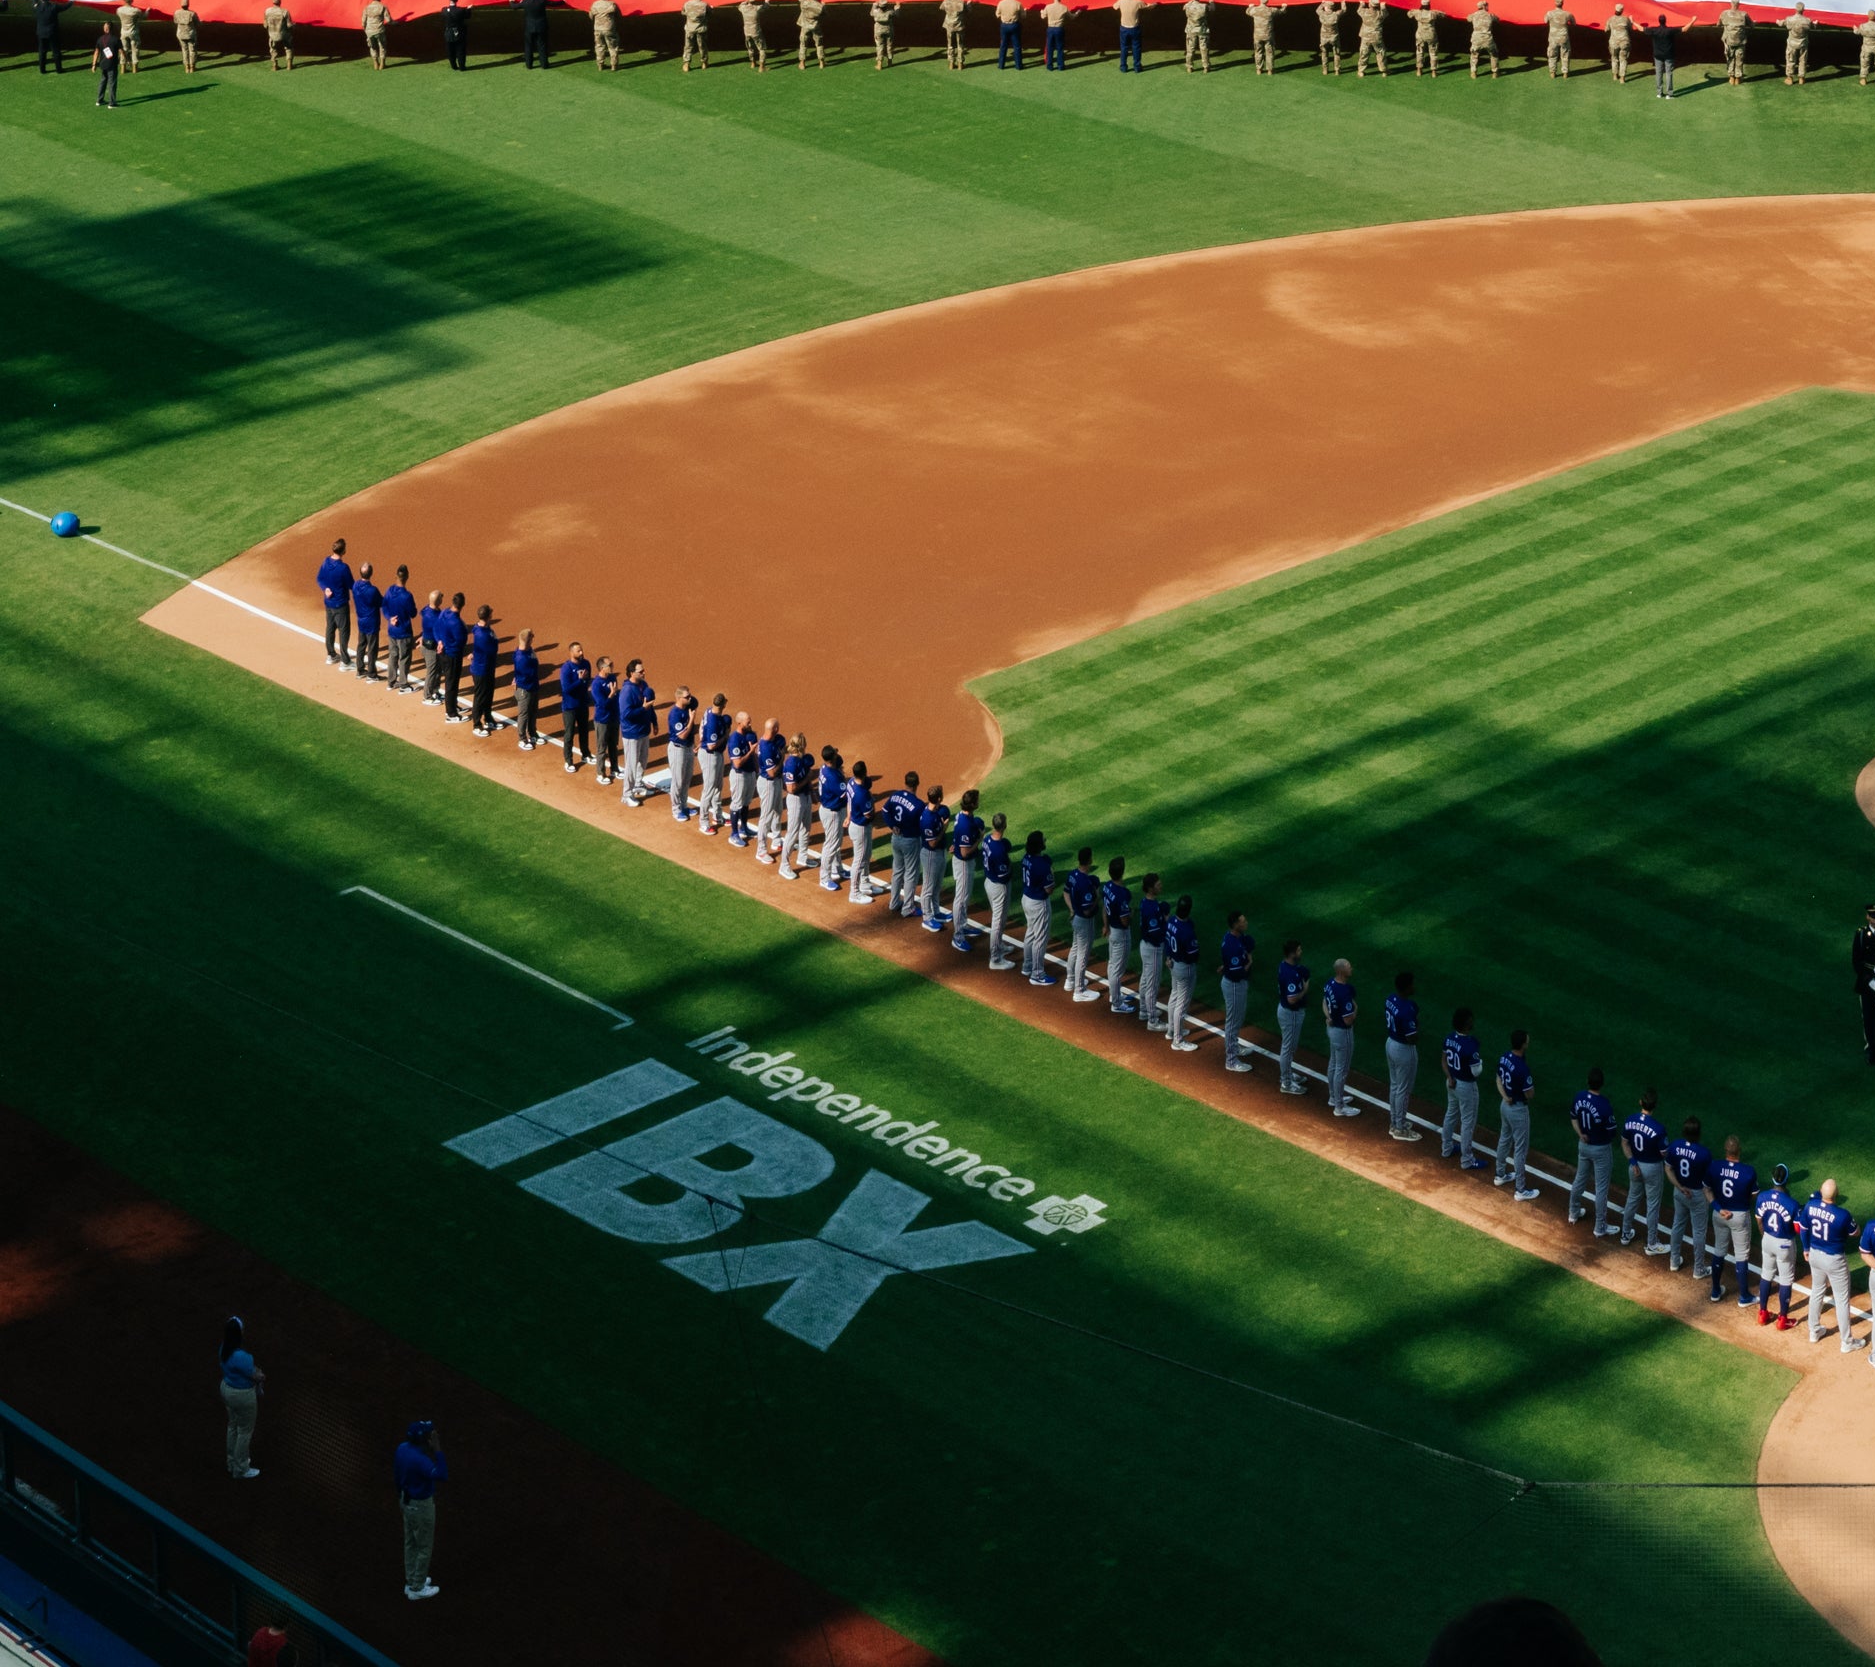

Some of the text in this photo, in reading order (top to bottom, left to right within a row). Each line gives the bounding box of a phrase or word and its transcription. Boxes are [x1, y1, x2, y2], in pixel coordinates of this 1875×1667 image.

[894, 805, 903, 823] 3
[685, 1025, 1036, 1202] Independence
[1581, 1110, 1591, 1131] 11
[1625, 1121, 1657, 1139] HAGGERTY
[1634, 1132, 1644, 1153] 0
[1676, 1147, 1697, 1161] SMITH
[1681, 1159, 1690, 1178] 8
[1720, 1168, 1739, 1180] JUNG
[1722, 1180, 1734, 1198] 6
[441, 1057, 1037, 1352] IBX
[1767, 1212, 1778, 1232] 4
[1808, 1207, 1836, 1223] BURGER
[1811, 1219, 1829, 1241] 21
